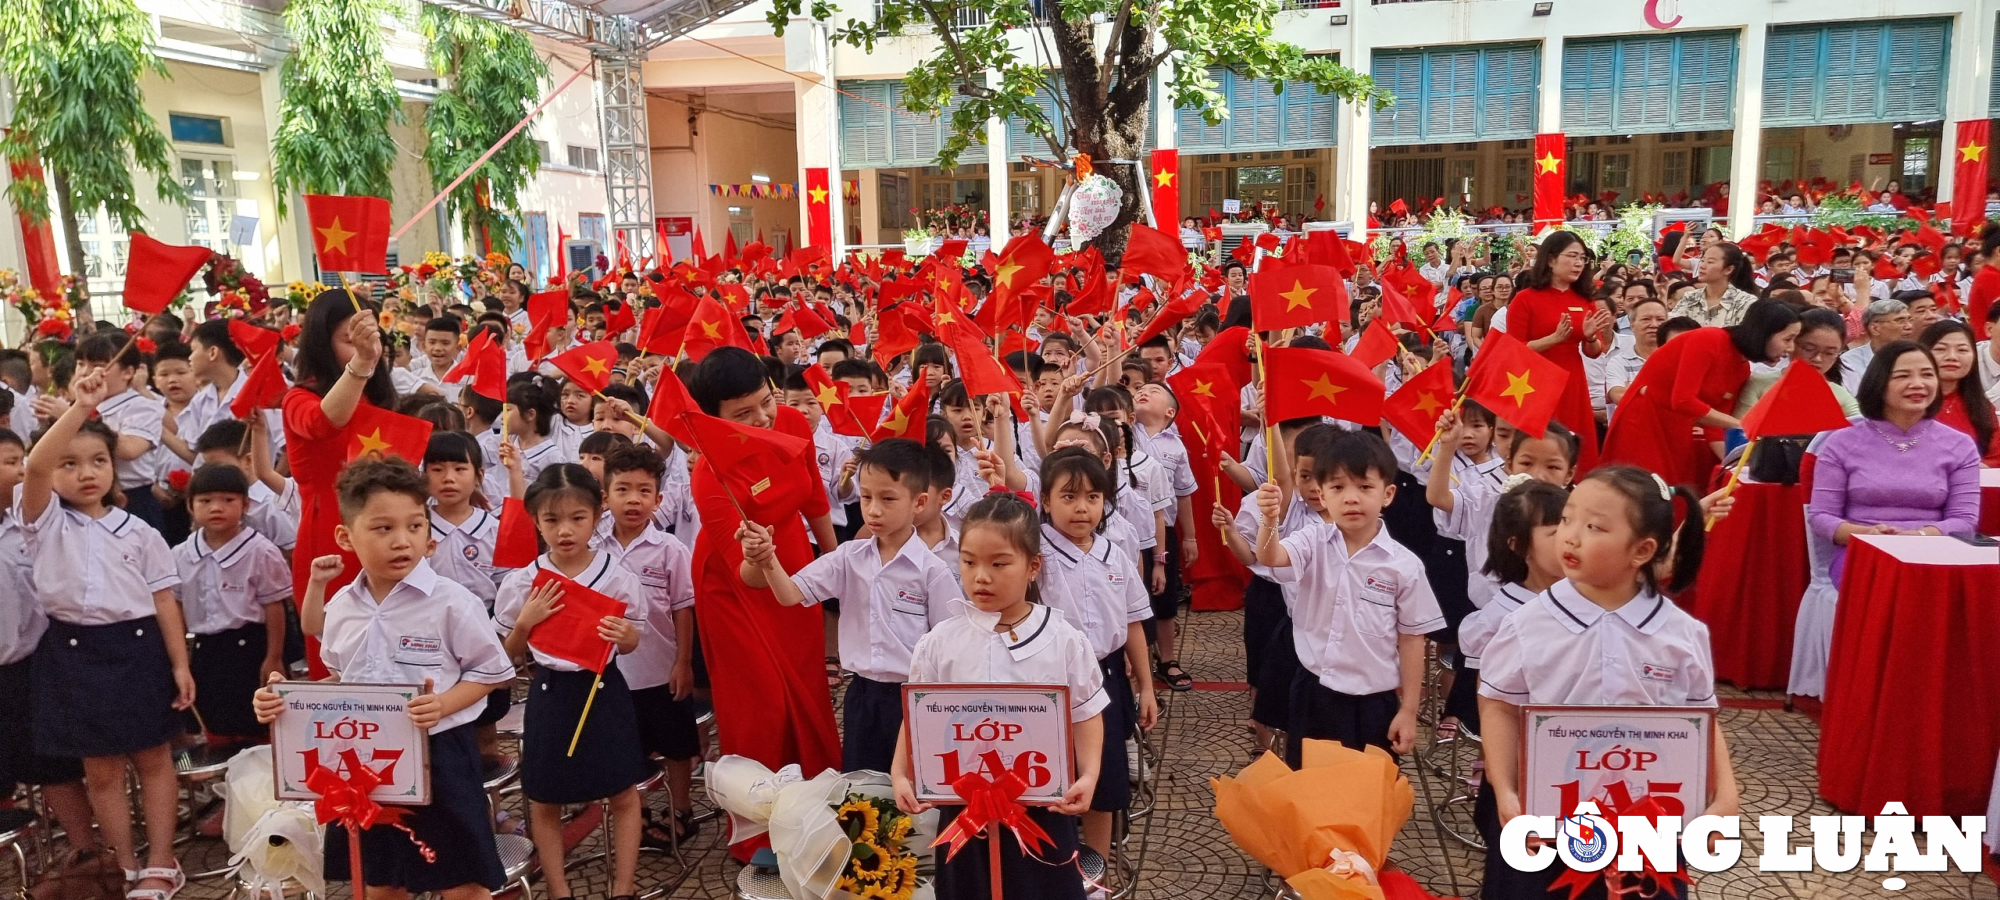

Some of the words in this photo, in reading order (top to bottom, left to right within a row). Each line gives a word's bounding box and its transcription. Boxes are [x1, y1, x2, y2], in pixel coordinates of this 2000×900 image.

[289, 700, 305, 710] TIỂU
[306, 703, 321, 712] HỌC
[322, 701, 352, 711] NGUYỄN
[354, 703, 365, 713] THỊ
[367, 704, 384, 712] MINH
[385, 704, 403, 712] KHAI
[926, 702, 942, 713] TIỂU
[944, 704, 960, 714] HỌC
[962, 702, 993, 713] NGUYỄN
[994, 704, 1007, 715] THỊ
[1009, 705, 1027, 713] MINH
[1028, 705, 1047, 713] KHAI
[313, 716, 380, 740] LỚP
[951, 717, 1023, 742] LỚP
[1548, 725, 1567, 738] TIỂU
[1569, 729, 1588, 740] HỌC
[1590, 727, 1626, 739] NGUYỄN
[1628, 730, 1642, 741] THỊ
[1644, 731, 1665, 739] MINH
[1667, 731, 1688, 740] KHAI
[296, 747, 405, 786] 1A7
[933, 749, 1052, 788] 1A6
[1575, 744, 1658, 771] LỚP
